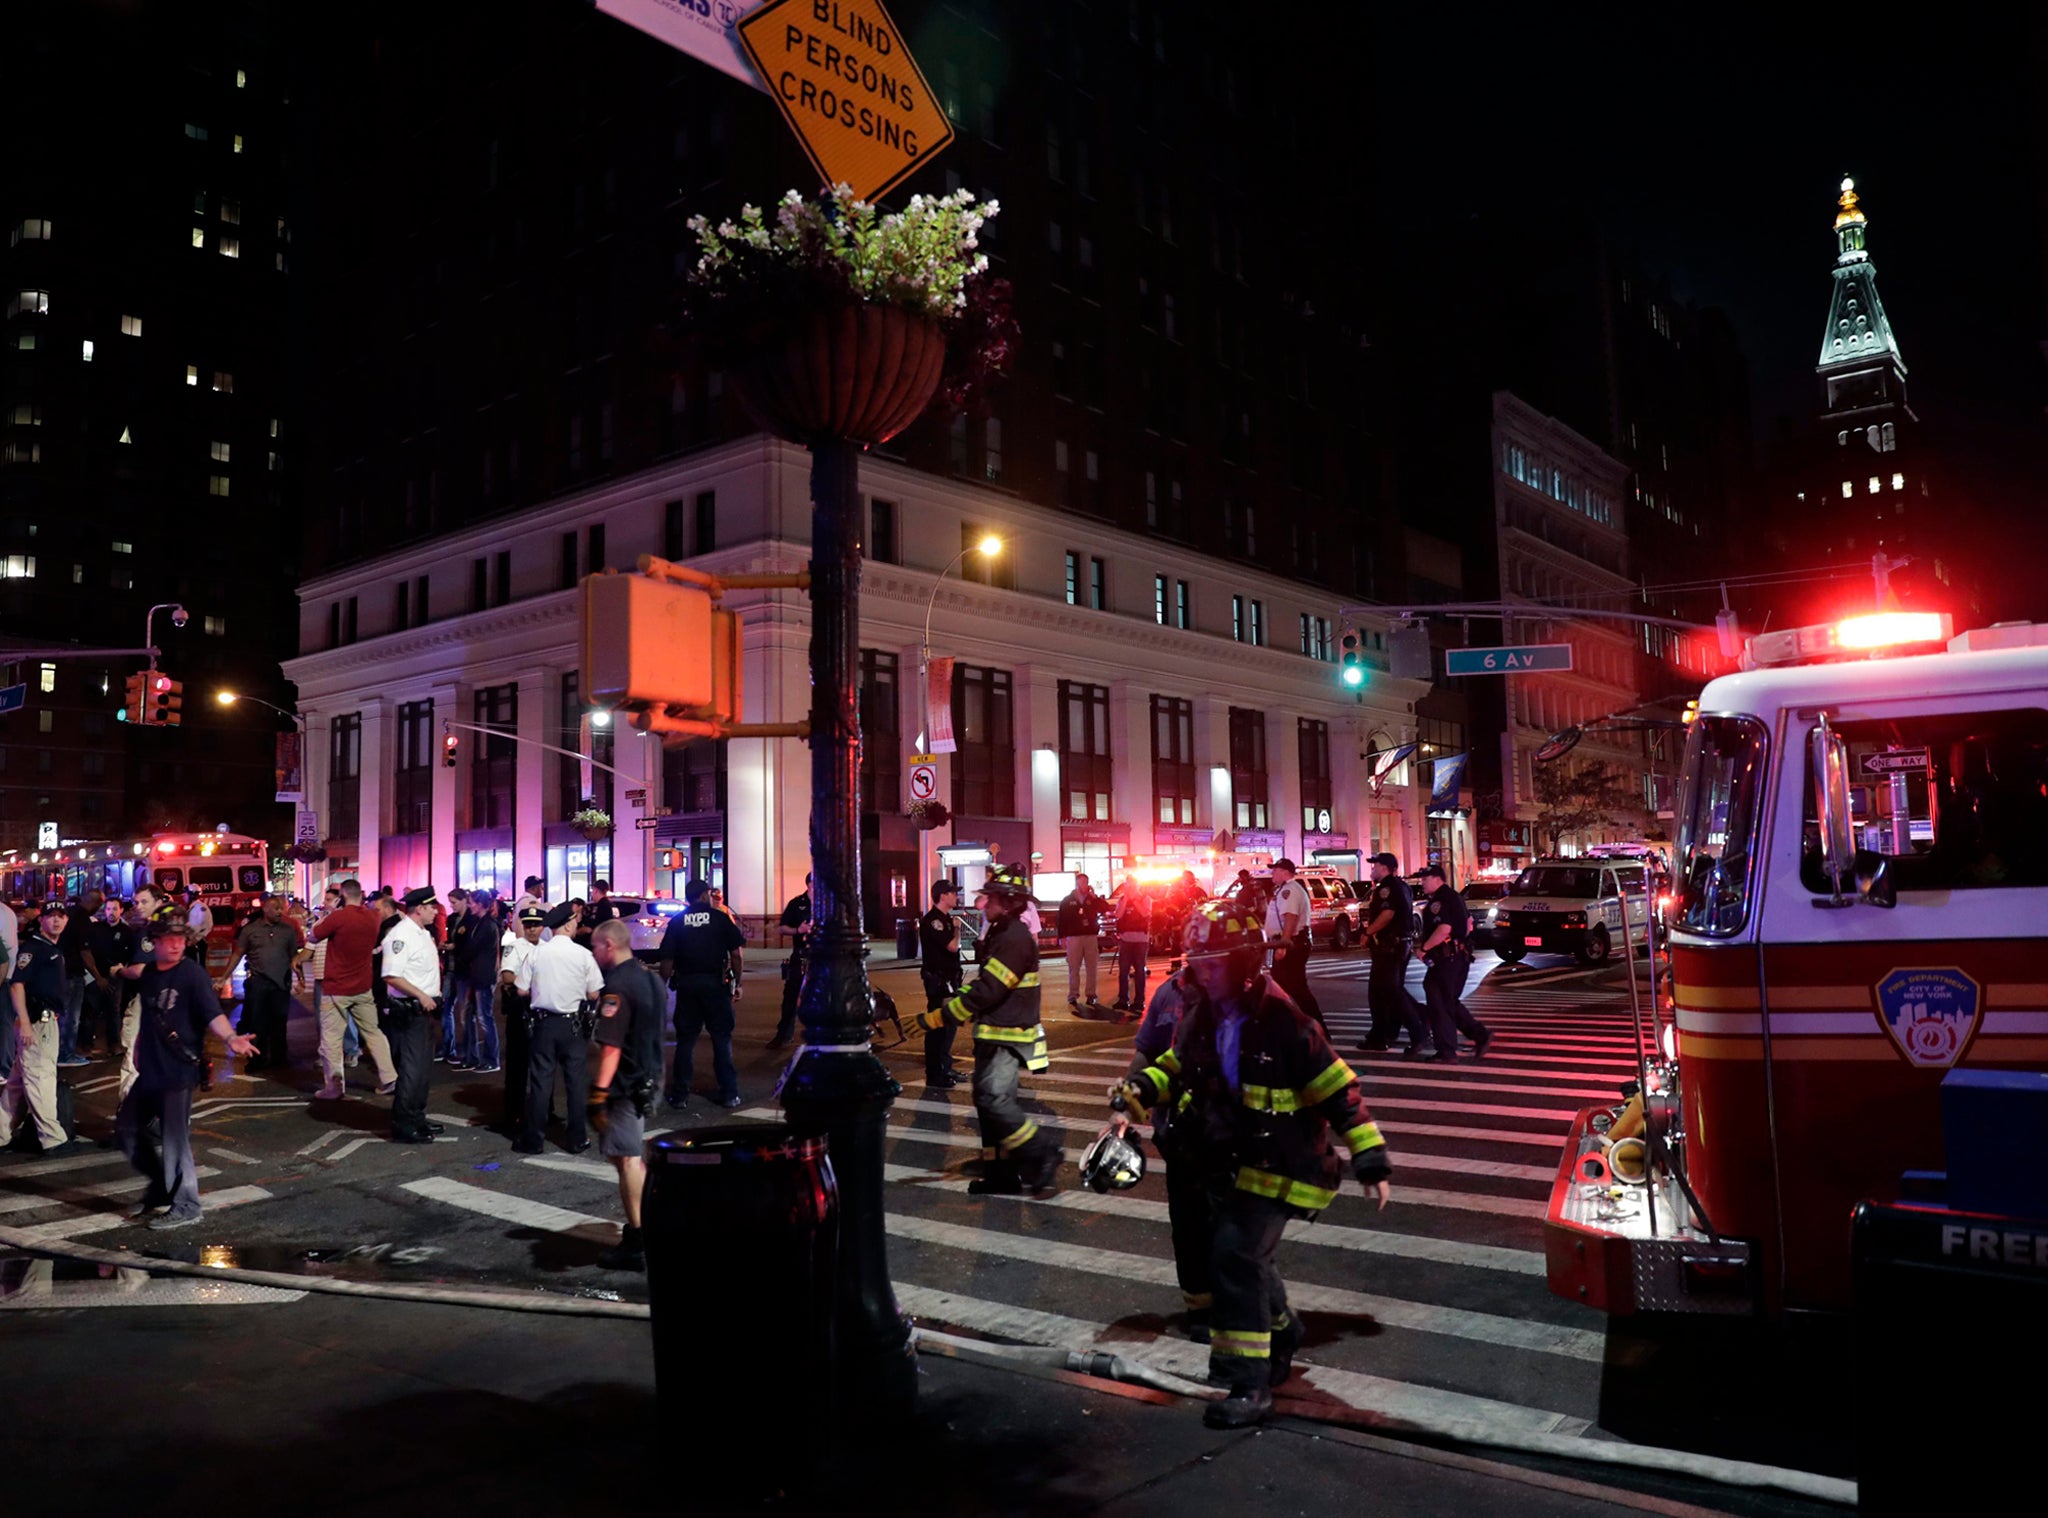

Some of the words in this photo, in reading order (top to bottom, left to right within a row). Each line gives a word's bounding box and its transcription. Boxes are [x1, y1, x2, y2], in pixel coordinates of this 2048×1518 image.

[813, 0, 891, 55] BLIND
[786, 24, 914, 112] PERSONS
[780, 71, 918, 157] CROSSING
[1484, 653, 1496, 669] 6
[1505, 652, 1534, 668] Av
[1871, 758, 1891, 768] ONE
[1901, 757, 1922, 766] WAY
[300, 825, 316, 836] 25
[684, 911, 711, 924] NYPD
[1907, 974, 1969, 993] DEPARTMENT
[1909, 985, 1930, 993] CITY
[1933, 985, 1946, 993] OF
[1928, 991, 1953, 999] YORK
